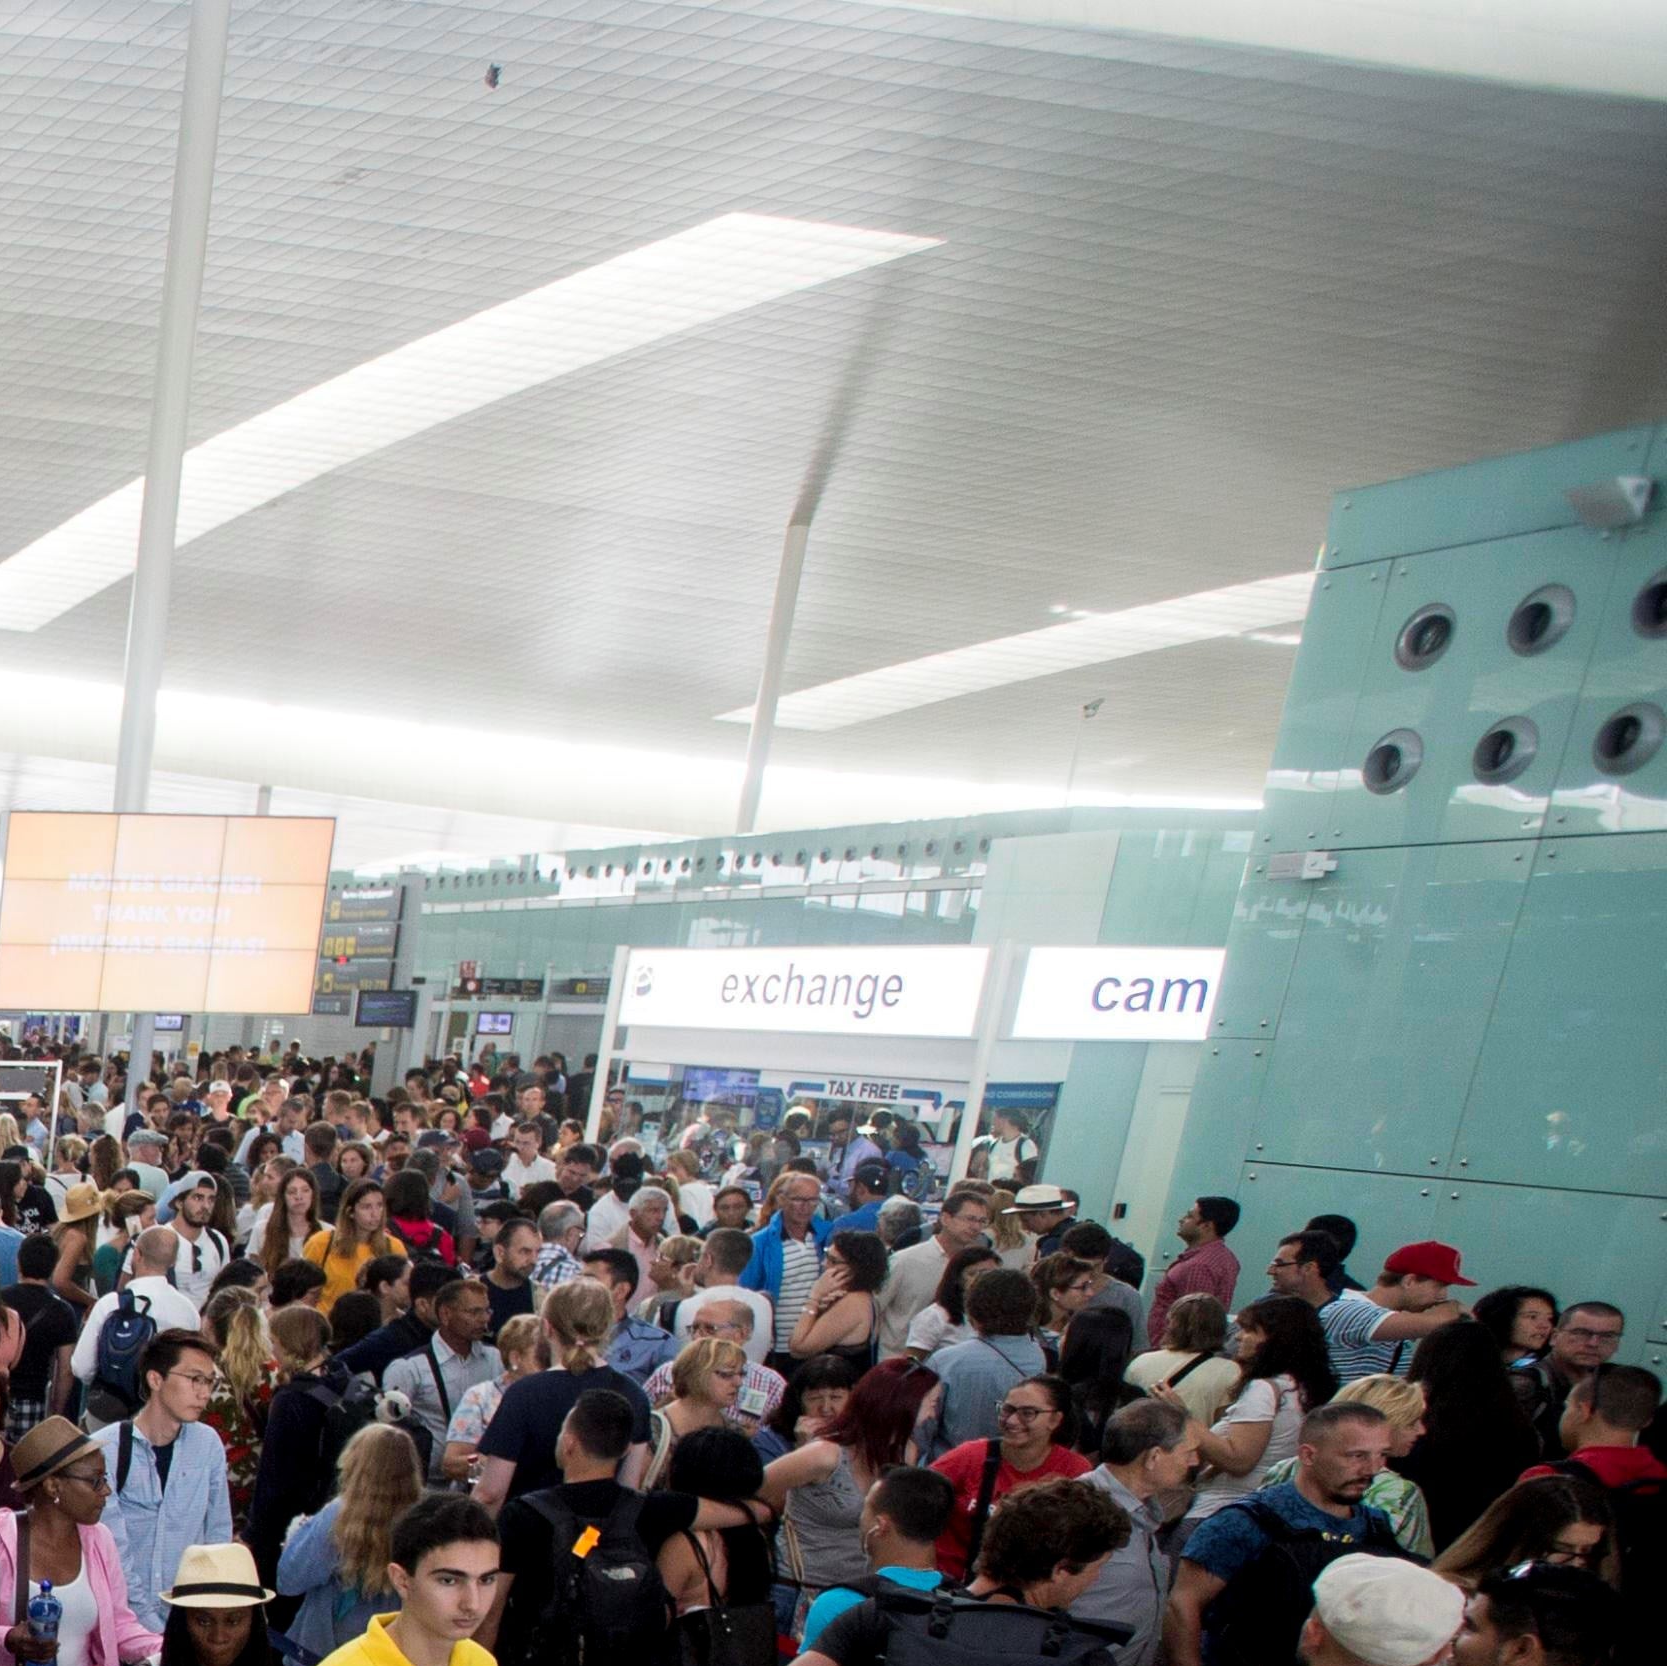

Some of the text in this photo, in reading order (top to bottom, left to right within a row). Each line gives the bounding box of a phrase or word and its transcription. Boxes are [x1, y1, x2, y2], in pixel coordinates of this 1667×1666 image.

[92, 904, 168, 922] THANK
[720, 963, 903, 1019] exchange
[1092, 977, 1208, 1012] cam
[827, 1080, 900, 1100] TAX FREE
